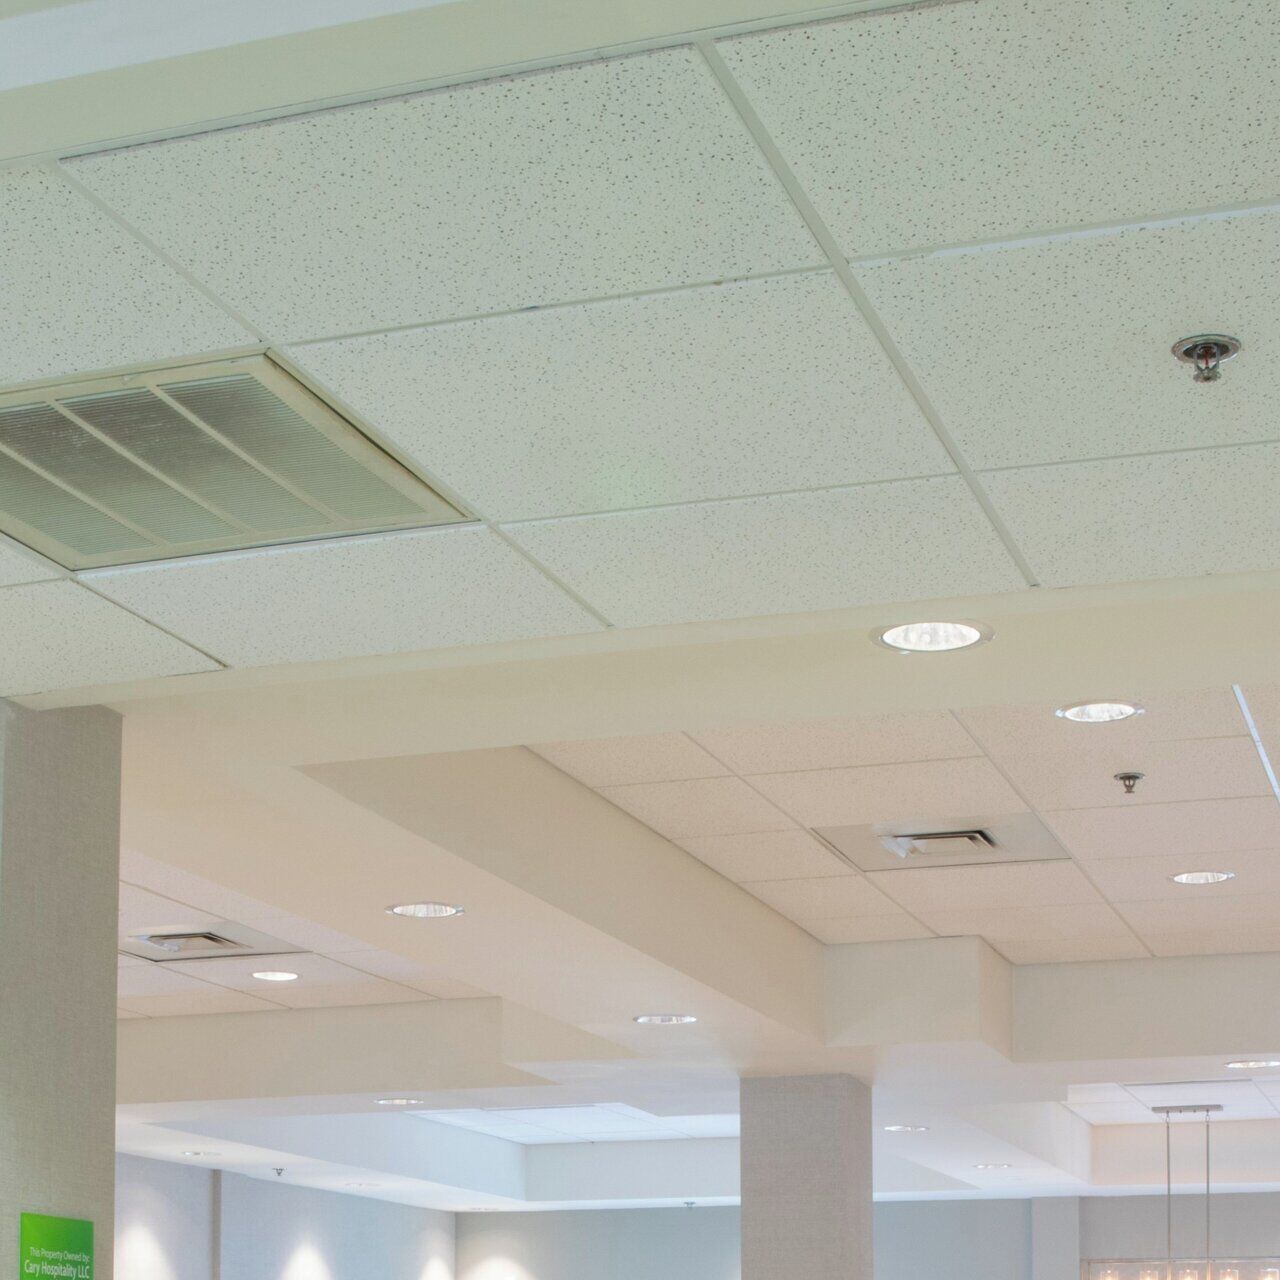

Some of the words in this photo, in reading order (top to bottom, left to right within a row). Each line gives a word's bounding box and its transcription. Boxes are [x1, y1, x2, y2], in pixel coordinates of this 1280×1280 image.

[30, 1246, 41, 1257] This
[41, 1248, 63, 1262] Property
[64, 1250, 81, 1262] Owned
[24, 1259, 40, 1277] Cary
[41, 1261, 77, 1280] Hospitality
[78, 1265, 90, 1279] LLC
